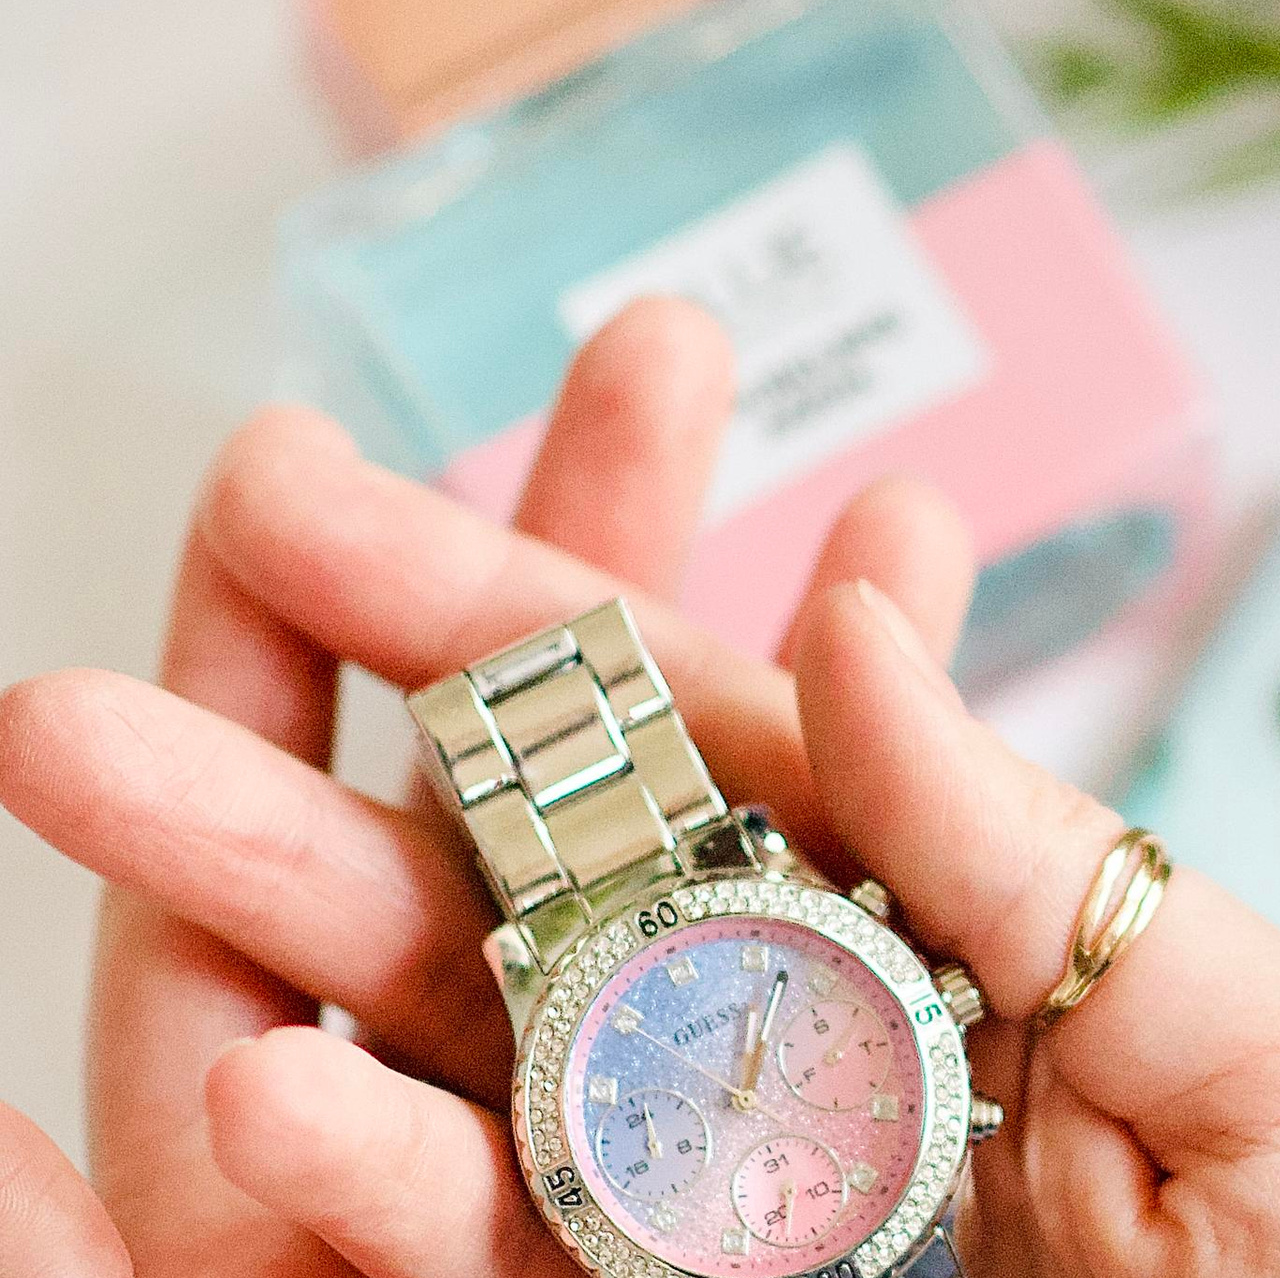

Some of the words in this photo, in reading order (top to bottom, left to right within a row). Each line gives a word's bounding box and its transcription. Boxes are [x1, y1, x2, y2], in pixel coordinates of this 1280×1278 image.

[638, 901, 678, 938] 60
[909, 993, 942, 1025] 15
[673, 1002, 741, 1045] GUESS
[813, 1018, 830, 1035] S
[858, 1040, 872, 1055] T
[803, 1067, 816, 1081] F
[677, 1138, 692, 1155] 8
[626, 1159, 650, 1179] 16
[763, 1153, 790, 1174] 31
[545, 1166, 582, 1206] 45
[805, 1180, 830, 1200] 10
